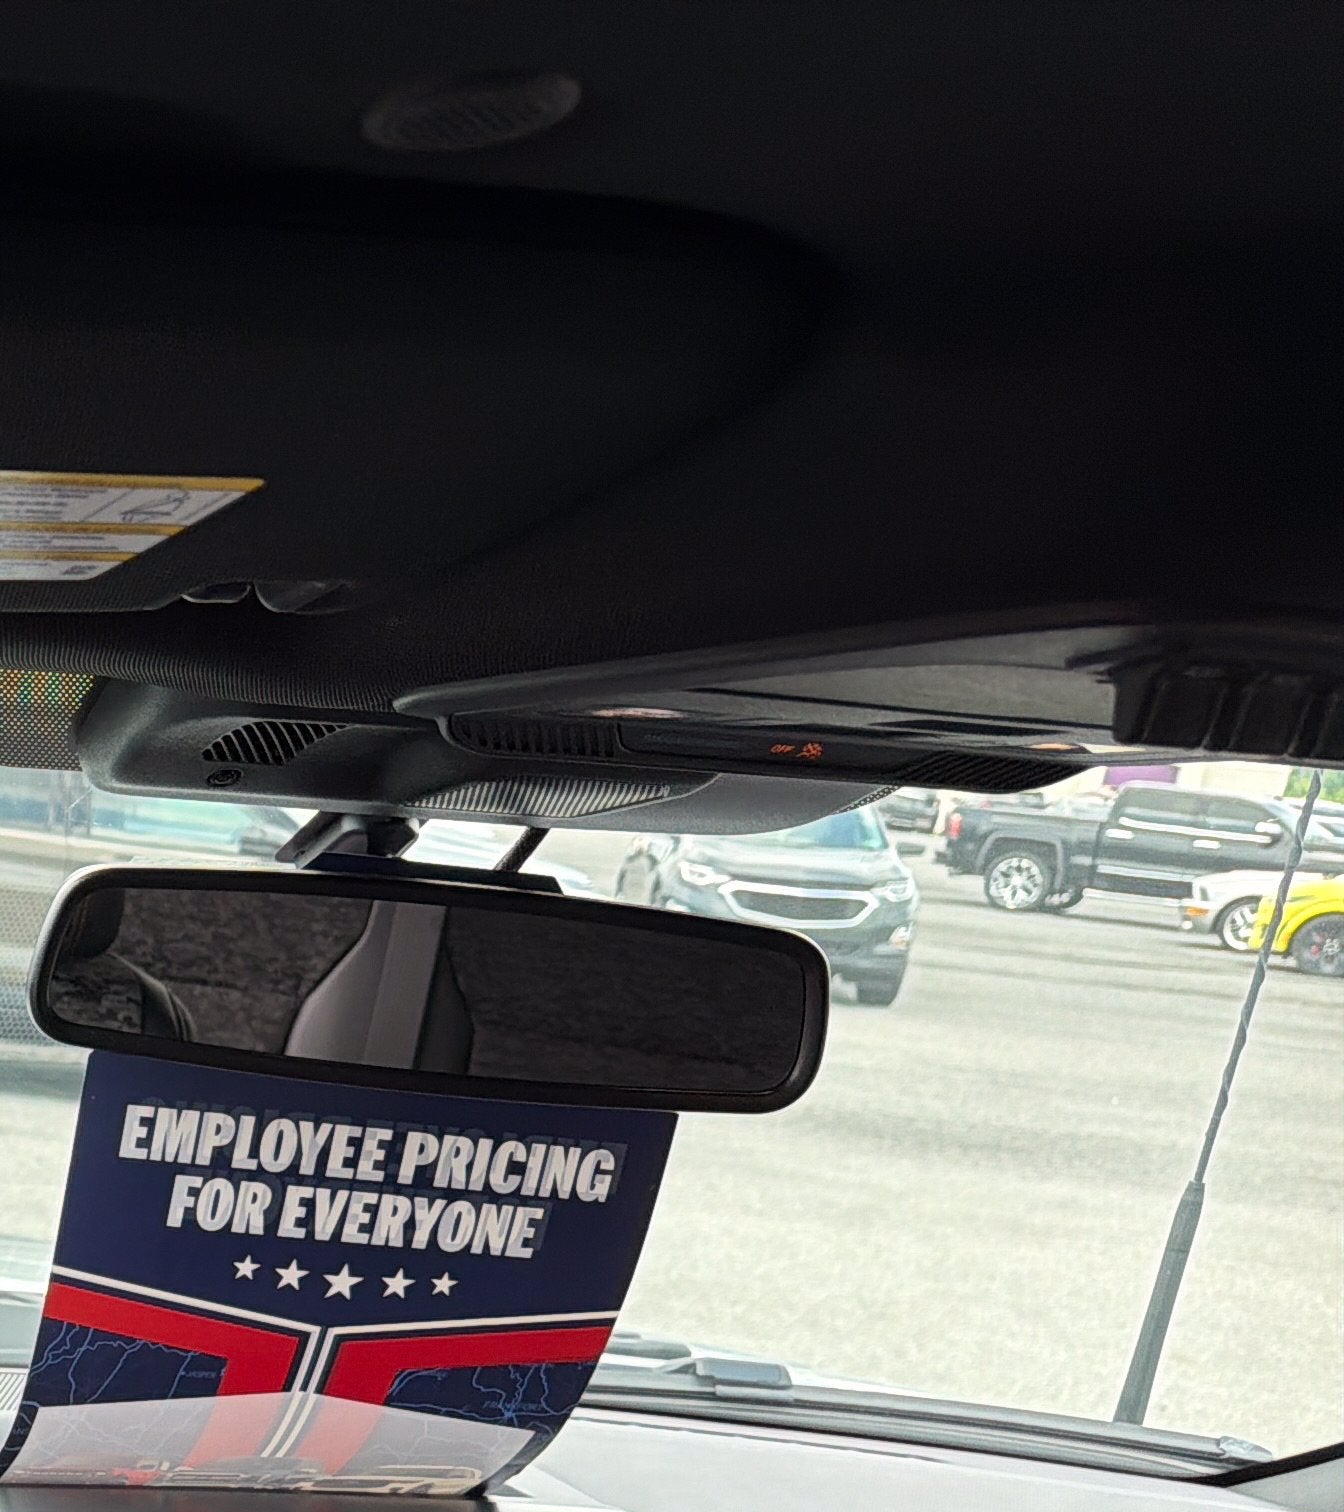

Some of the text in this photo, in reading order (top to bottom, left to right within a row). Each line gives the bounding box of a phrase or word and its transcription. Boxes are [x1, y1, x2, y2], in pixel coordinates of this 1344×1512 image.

[118, 1104, 616, 1203] EMPLOYEE PRICING
[165, 1174, 544, 1260] FOR EVERYONE
